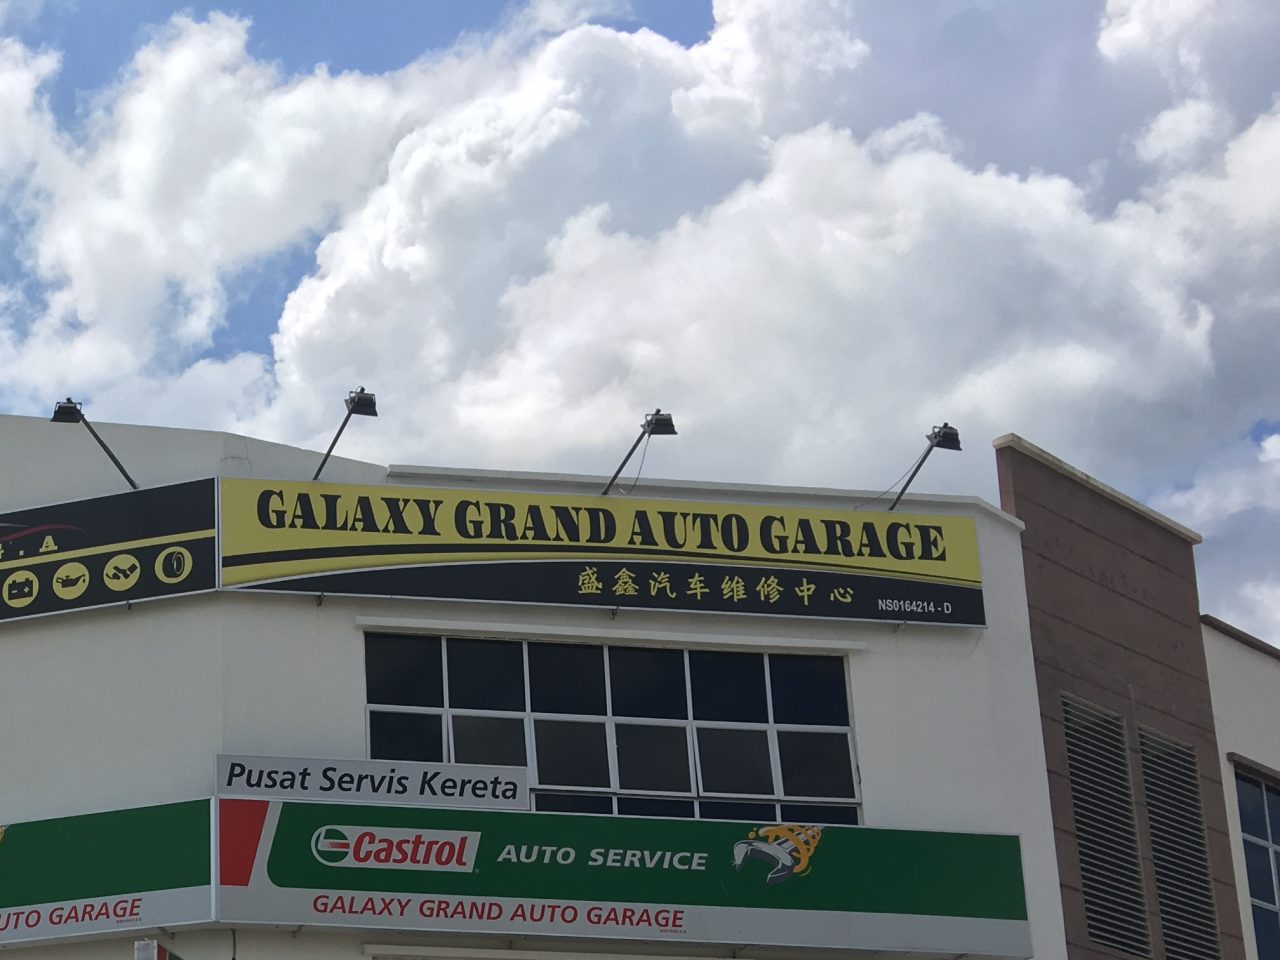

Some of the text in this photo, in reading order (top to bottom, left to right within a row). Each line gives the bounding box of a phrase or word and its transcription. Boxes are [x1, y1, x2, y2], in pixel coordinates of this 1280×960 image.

[257, 489, 947, 562] GALAXY GRAND AUTO GARAGE
[578, 566, 853, 605] 盛鑫汽车维修中心
[226, 762, 519, 800] Pusat Servis Kereta
[352, 831, 708, 871] Castrol AUTO SERVICE
[48, 897, 143, 926] GARAGE
[312, 894, 685, 928] GALAXY GRAND AUTO GARAGE
